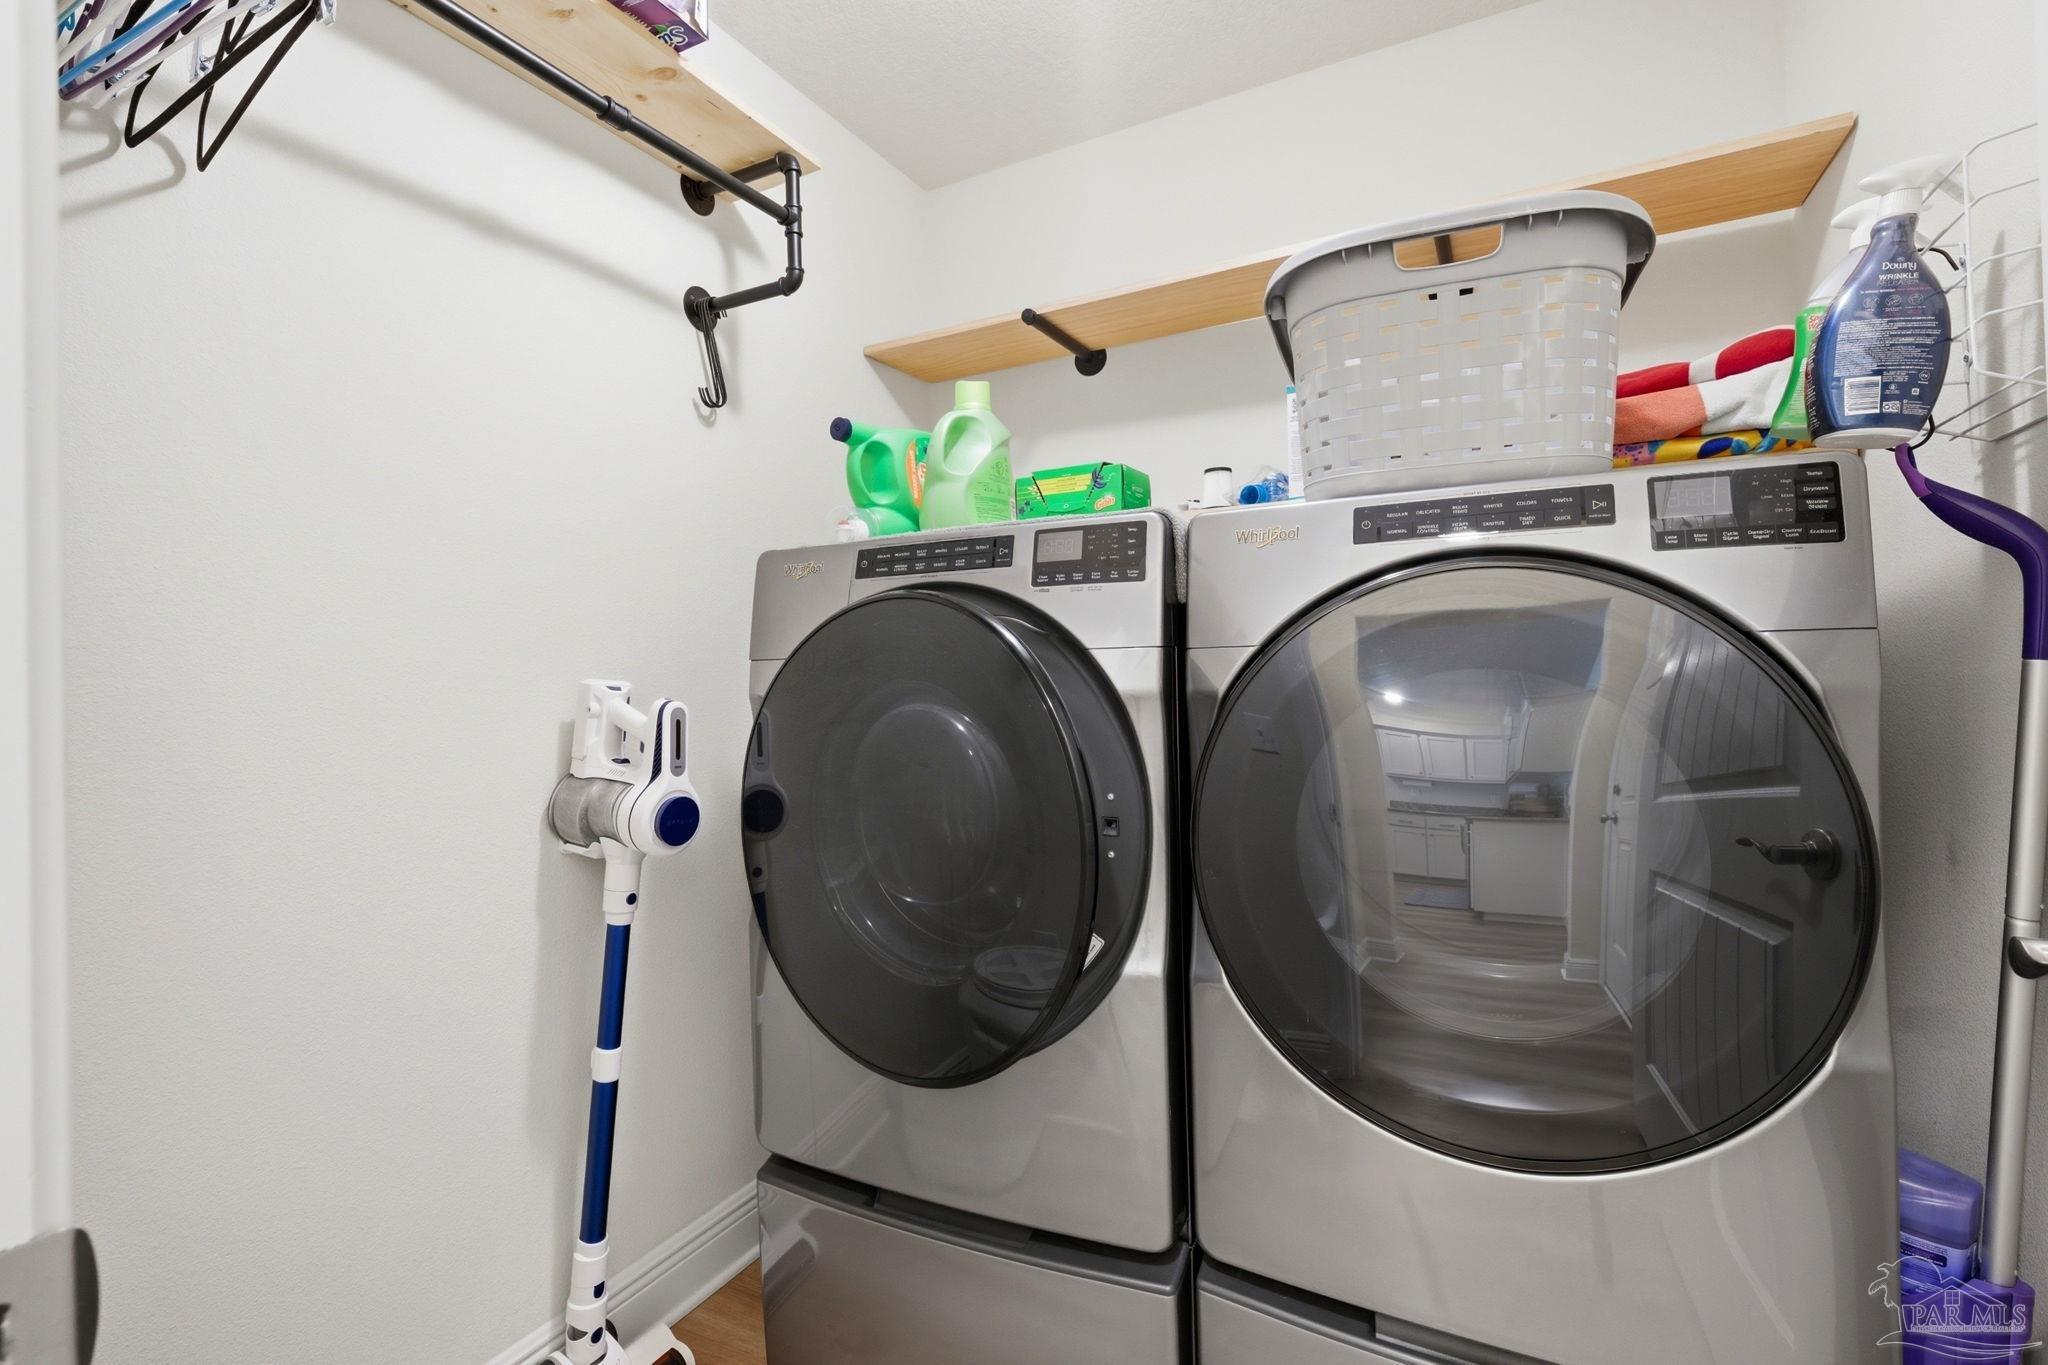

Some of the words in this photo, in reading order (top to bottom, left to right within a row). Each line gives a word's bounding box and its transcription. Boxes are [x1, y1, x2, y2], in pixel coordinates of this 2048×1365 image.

[1882, 261, 1917, 271] Downy
[1879, 271, 1919, 281] WRINKLE
[1235, 525, 1301, 548] Whirlpool
